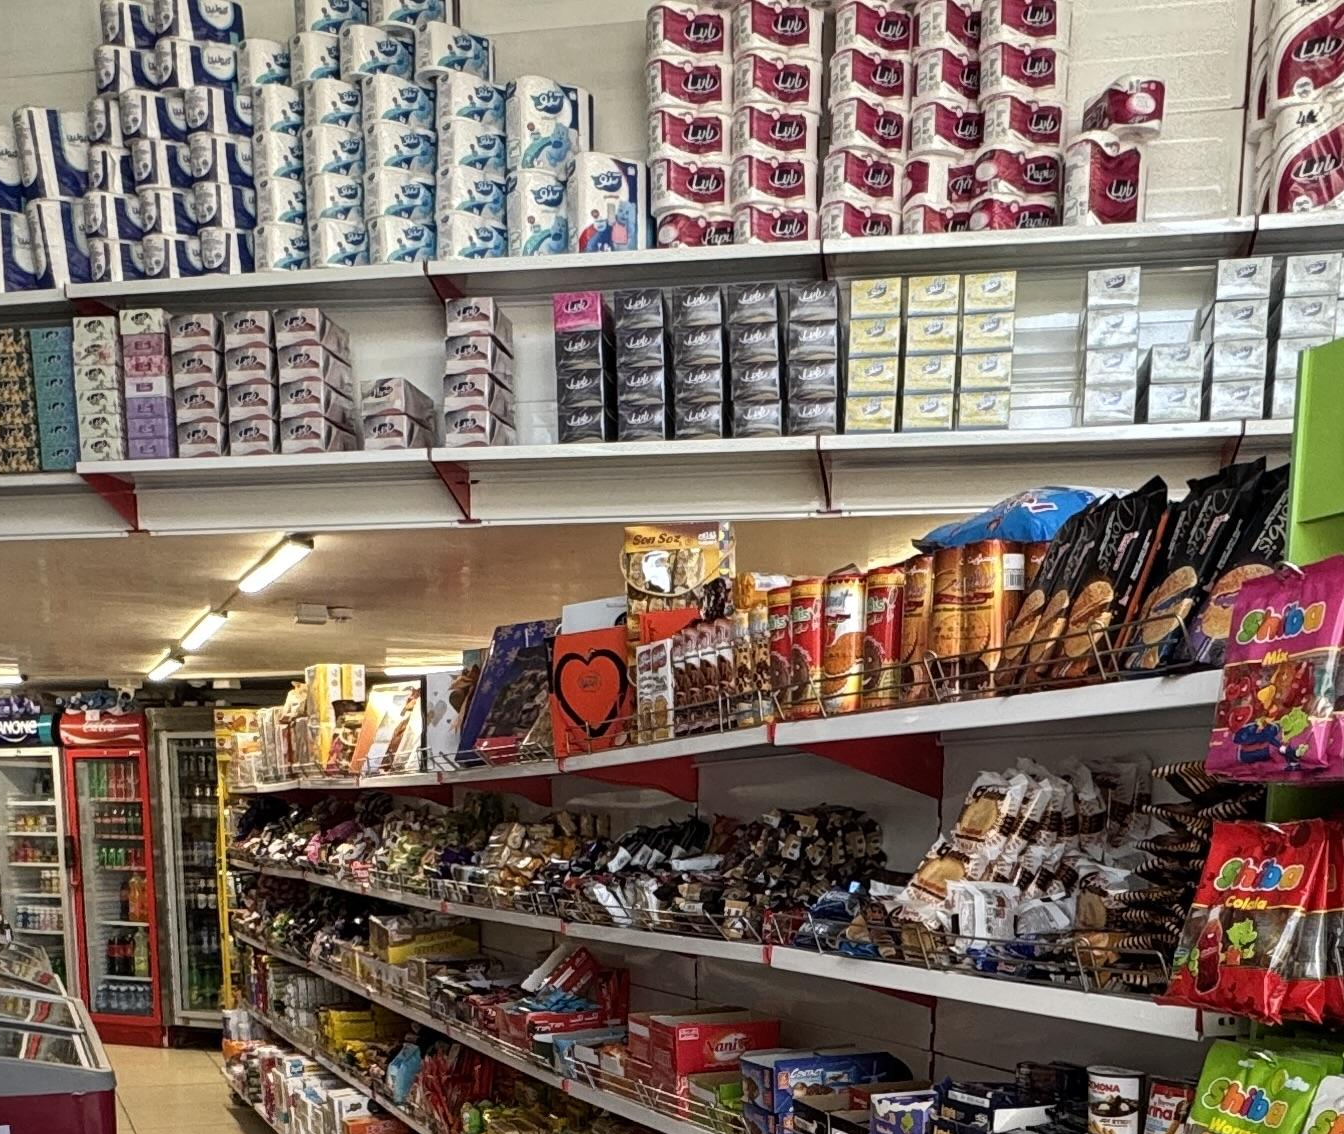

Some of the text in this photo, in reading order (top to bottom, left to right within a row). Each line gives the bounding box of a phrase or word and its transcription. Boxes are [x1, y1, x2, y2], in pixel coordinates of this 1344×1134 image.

[1236, 600, 1327, 646] Shiba
[1261, 648, 1290, 667] Mix
[1213, 855, 1306, 894] Shiba
[1201, 1076, 1286, 1130] Shiba
